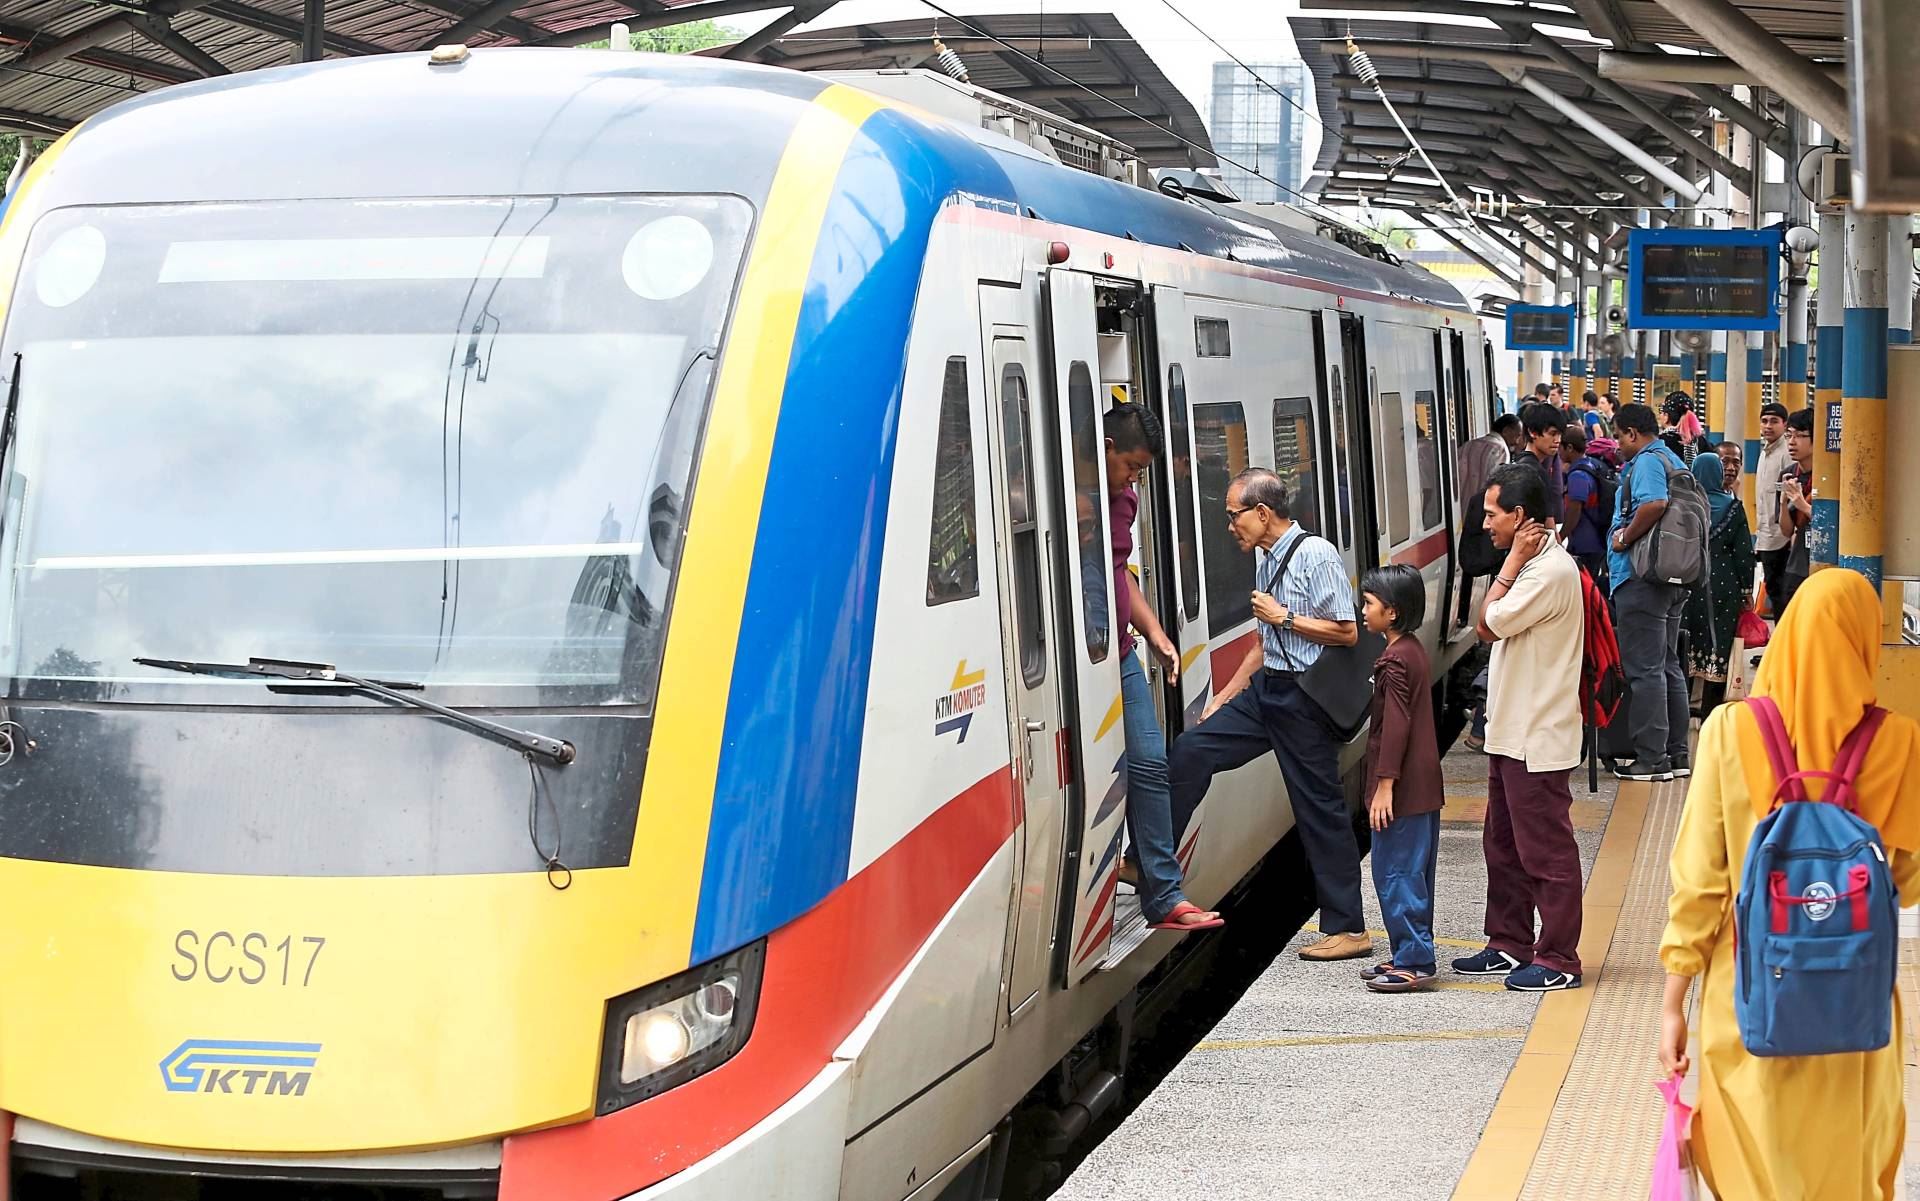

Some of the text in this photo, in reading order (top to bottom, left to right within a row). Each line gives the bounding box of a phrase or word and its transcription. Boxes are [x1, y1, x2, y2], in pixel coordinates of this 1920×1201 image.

[935, 684, 986, 720] KTM KOMUTER
[171, 929, 326, 987] SCS17
[203, 1068, 312, 1097] KTM
